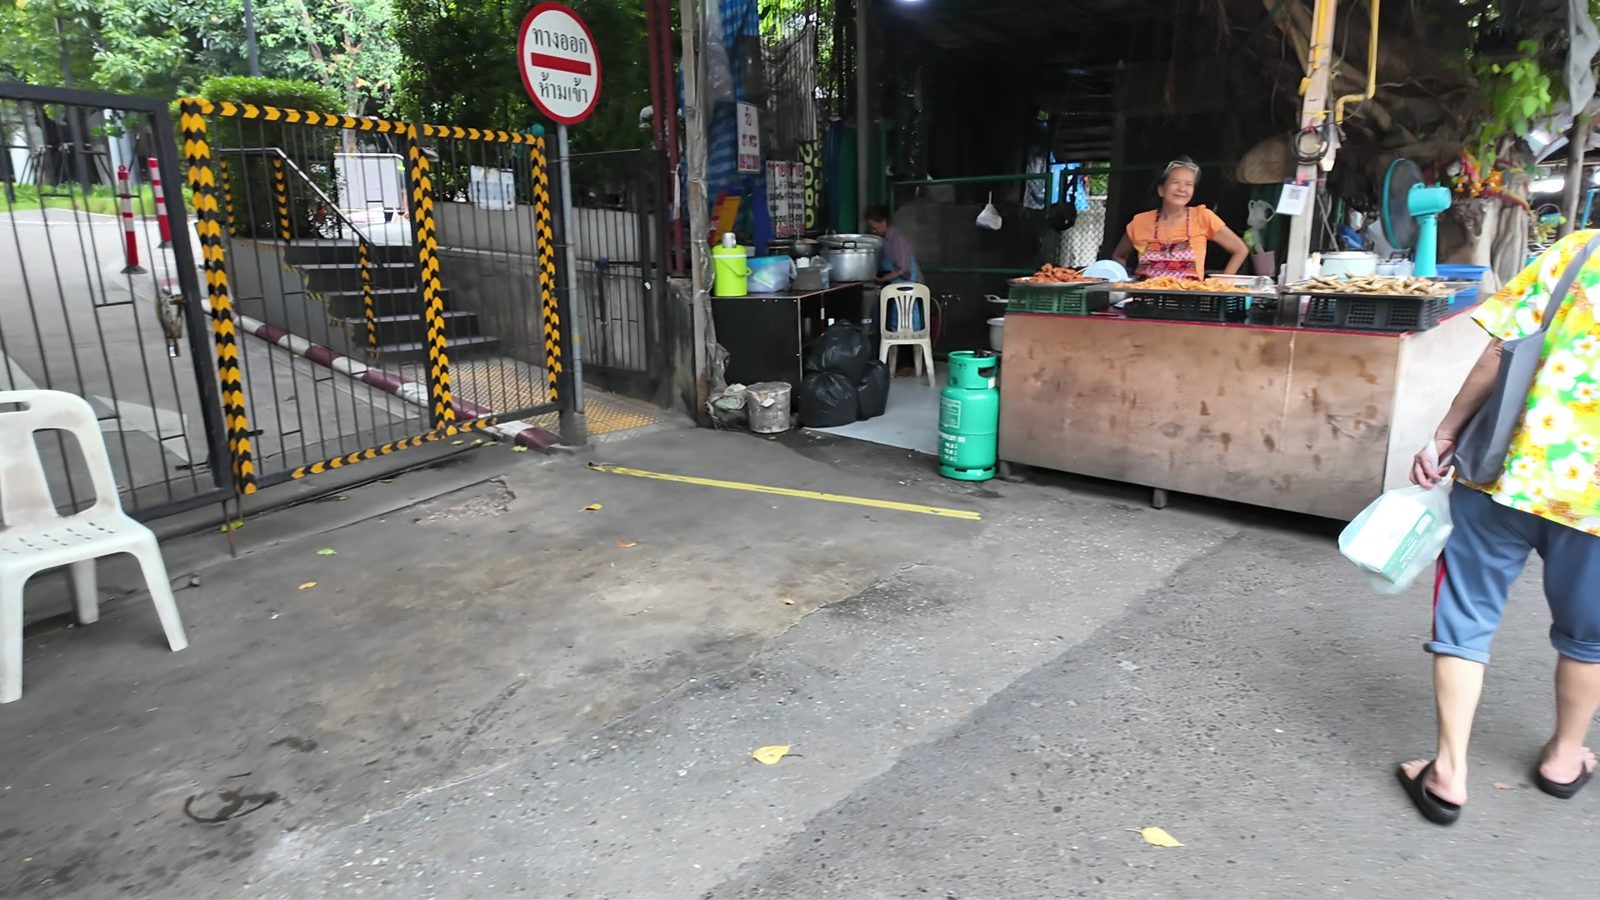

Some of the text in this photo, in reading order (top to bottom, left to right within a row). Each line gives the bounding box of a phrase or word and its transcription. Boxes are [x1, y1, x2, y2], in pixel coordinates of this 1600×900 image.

[532, 28, 588, 54] ทางออก
[539, 72, 588, 103] ห้ามเข้า
